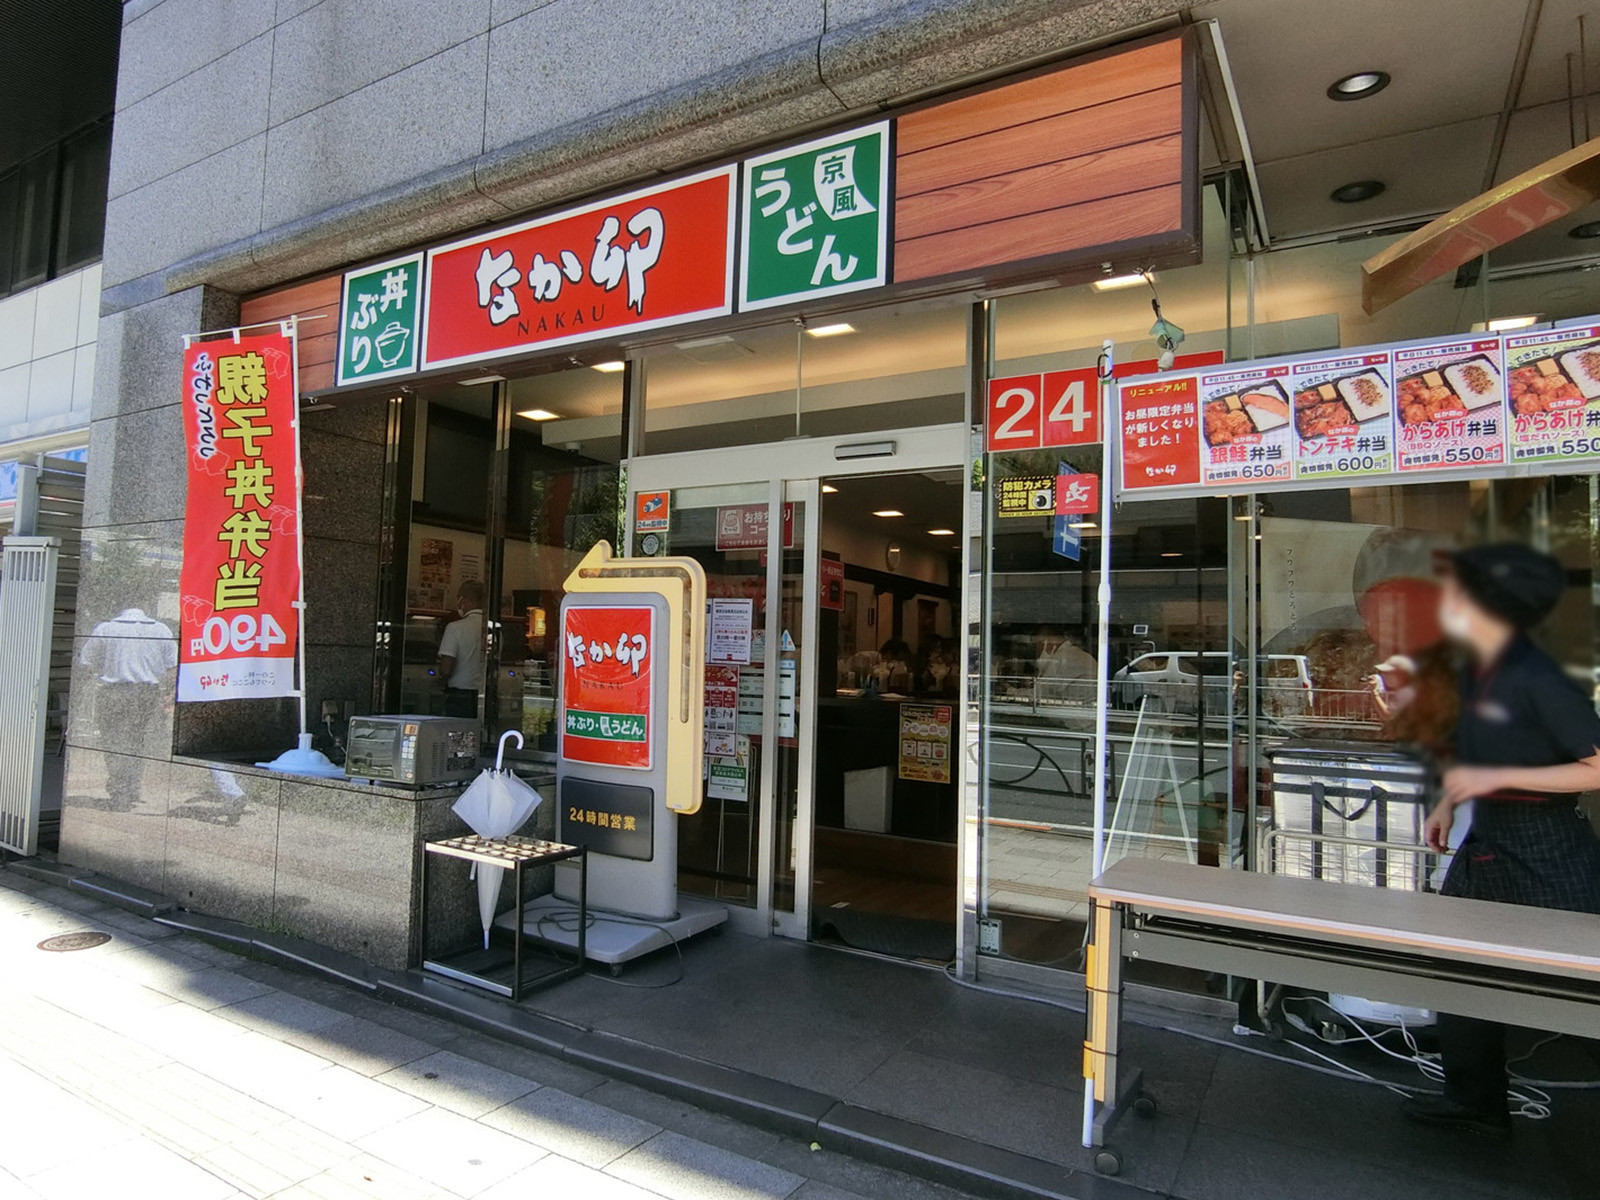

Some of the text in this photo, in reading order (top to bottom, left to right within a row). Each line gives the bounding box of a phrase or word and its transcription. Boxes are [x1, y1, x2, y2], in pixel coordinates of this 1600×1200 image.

[822, 155, 858, 215] 京風
[755, 166, 859, 287] うどん
[475, 207, 664, 327] なか卯
[350, 269, 408, 374] 丼ぶり
[517, 304, 607, 338] NAKAU
[994, 380, 1092, 440] 24
[1124, 402, 1195, 421] お昼限定弁当
[1124, 417, 1195, 435] が新しくなり
[1402, 418, 1498, 442] からあげ弁当
[1137, 434, 1181, 448] ました！
[1298, 434, 1386, 457] トンテキ弁当
[1209, 444, 1282, 464] 銀鮭弁当
[1337, 456, 1383, 472] 600円
[1445, 446, 1494, 463] 550円
[1242, 463, 1282, 479] 650円
[1002, 479, 1052, 492] 防犯カメラ
[567, 632, 648, 680] なか卯
[568, 806, 637, 832] 24時間営業
